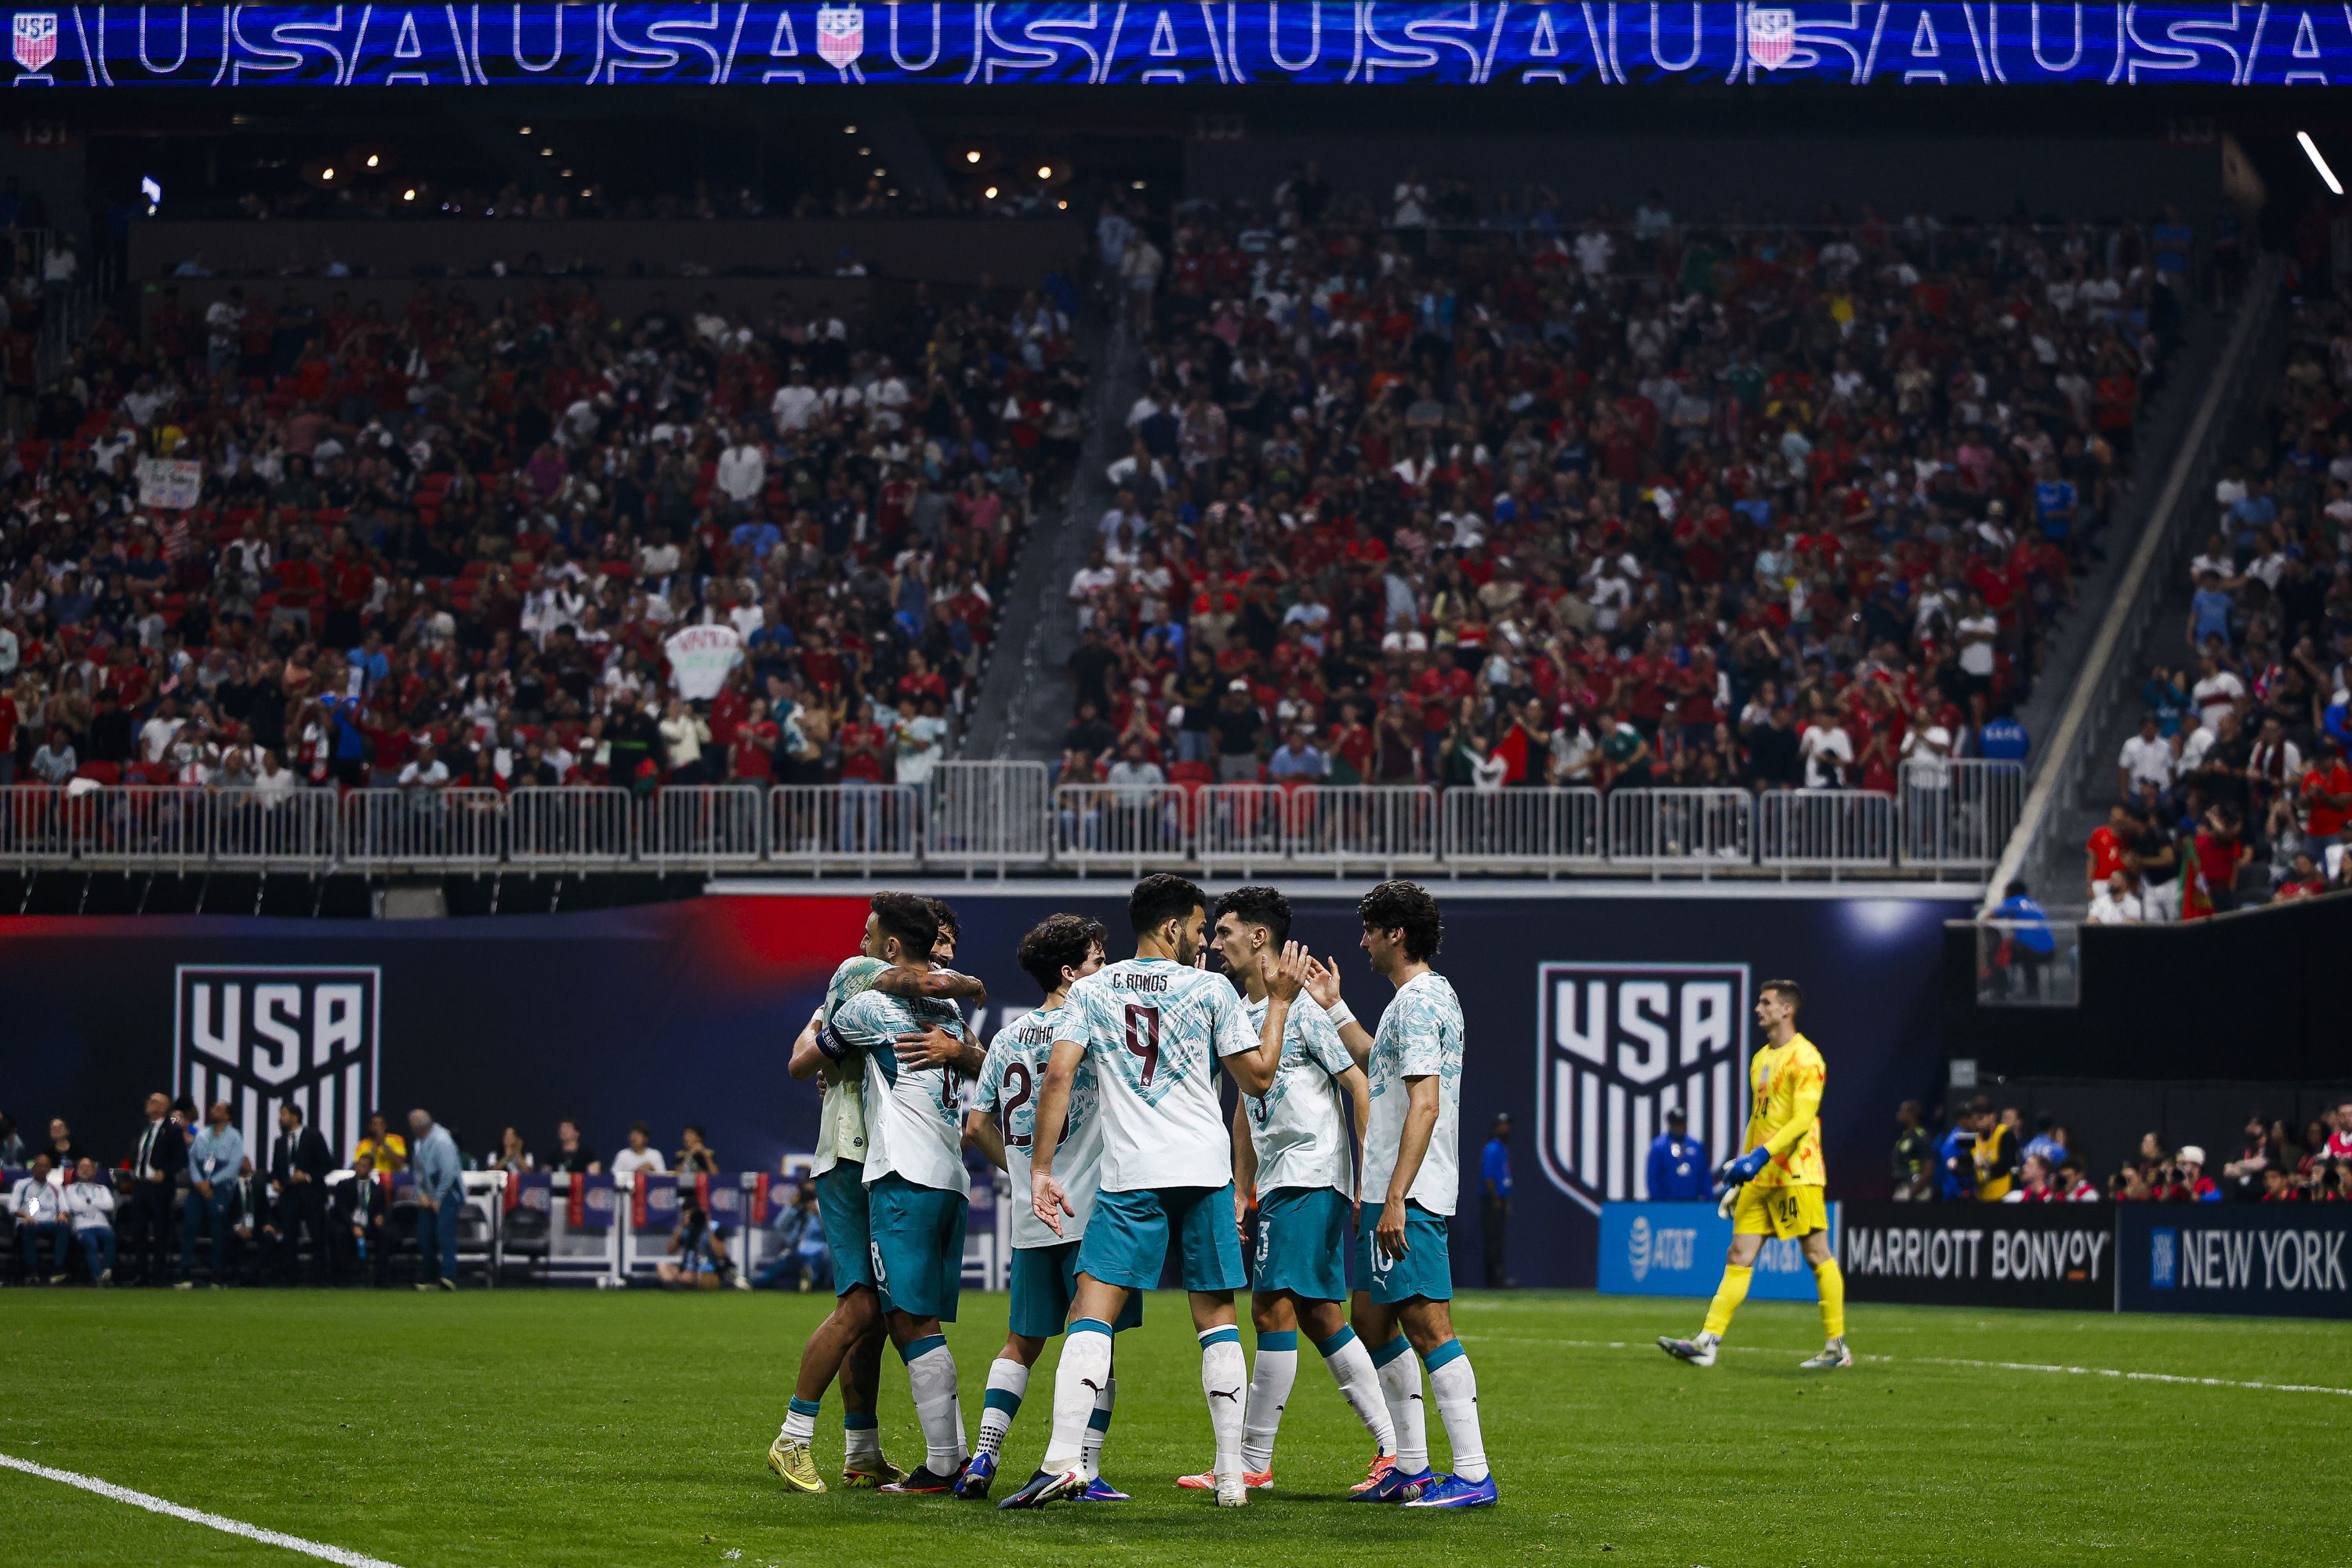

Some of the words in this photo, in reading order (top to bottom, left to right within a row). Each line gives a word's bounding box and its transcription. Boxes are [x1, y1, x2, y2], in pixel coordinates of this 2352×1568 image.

[17, 17, 54, 38] USA
[1127, 974, 1167, 992] RAMOS
[193, 982, 362, 1086] USA
[1124, 1004, 1160, 1087] 9
[1555, 981, 1731, 1085] USA
[1003, 1062, 1070, 1148] 2
[1779, 1196, 1798, 1222] 24
[1256, 1221, 1271, 1261] 3
[1652, 1229, 1697, 1269] AT&T
[1846, 1227, 1984, 1279] MARRIOTT
[2182, 1229, 2255, 1289] NEW
[2258, 1229, 2347, 1290] YORK
